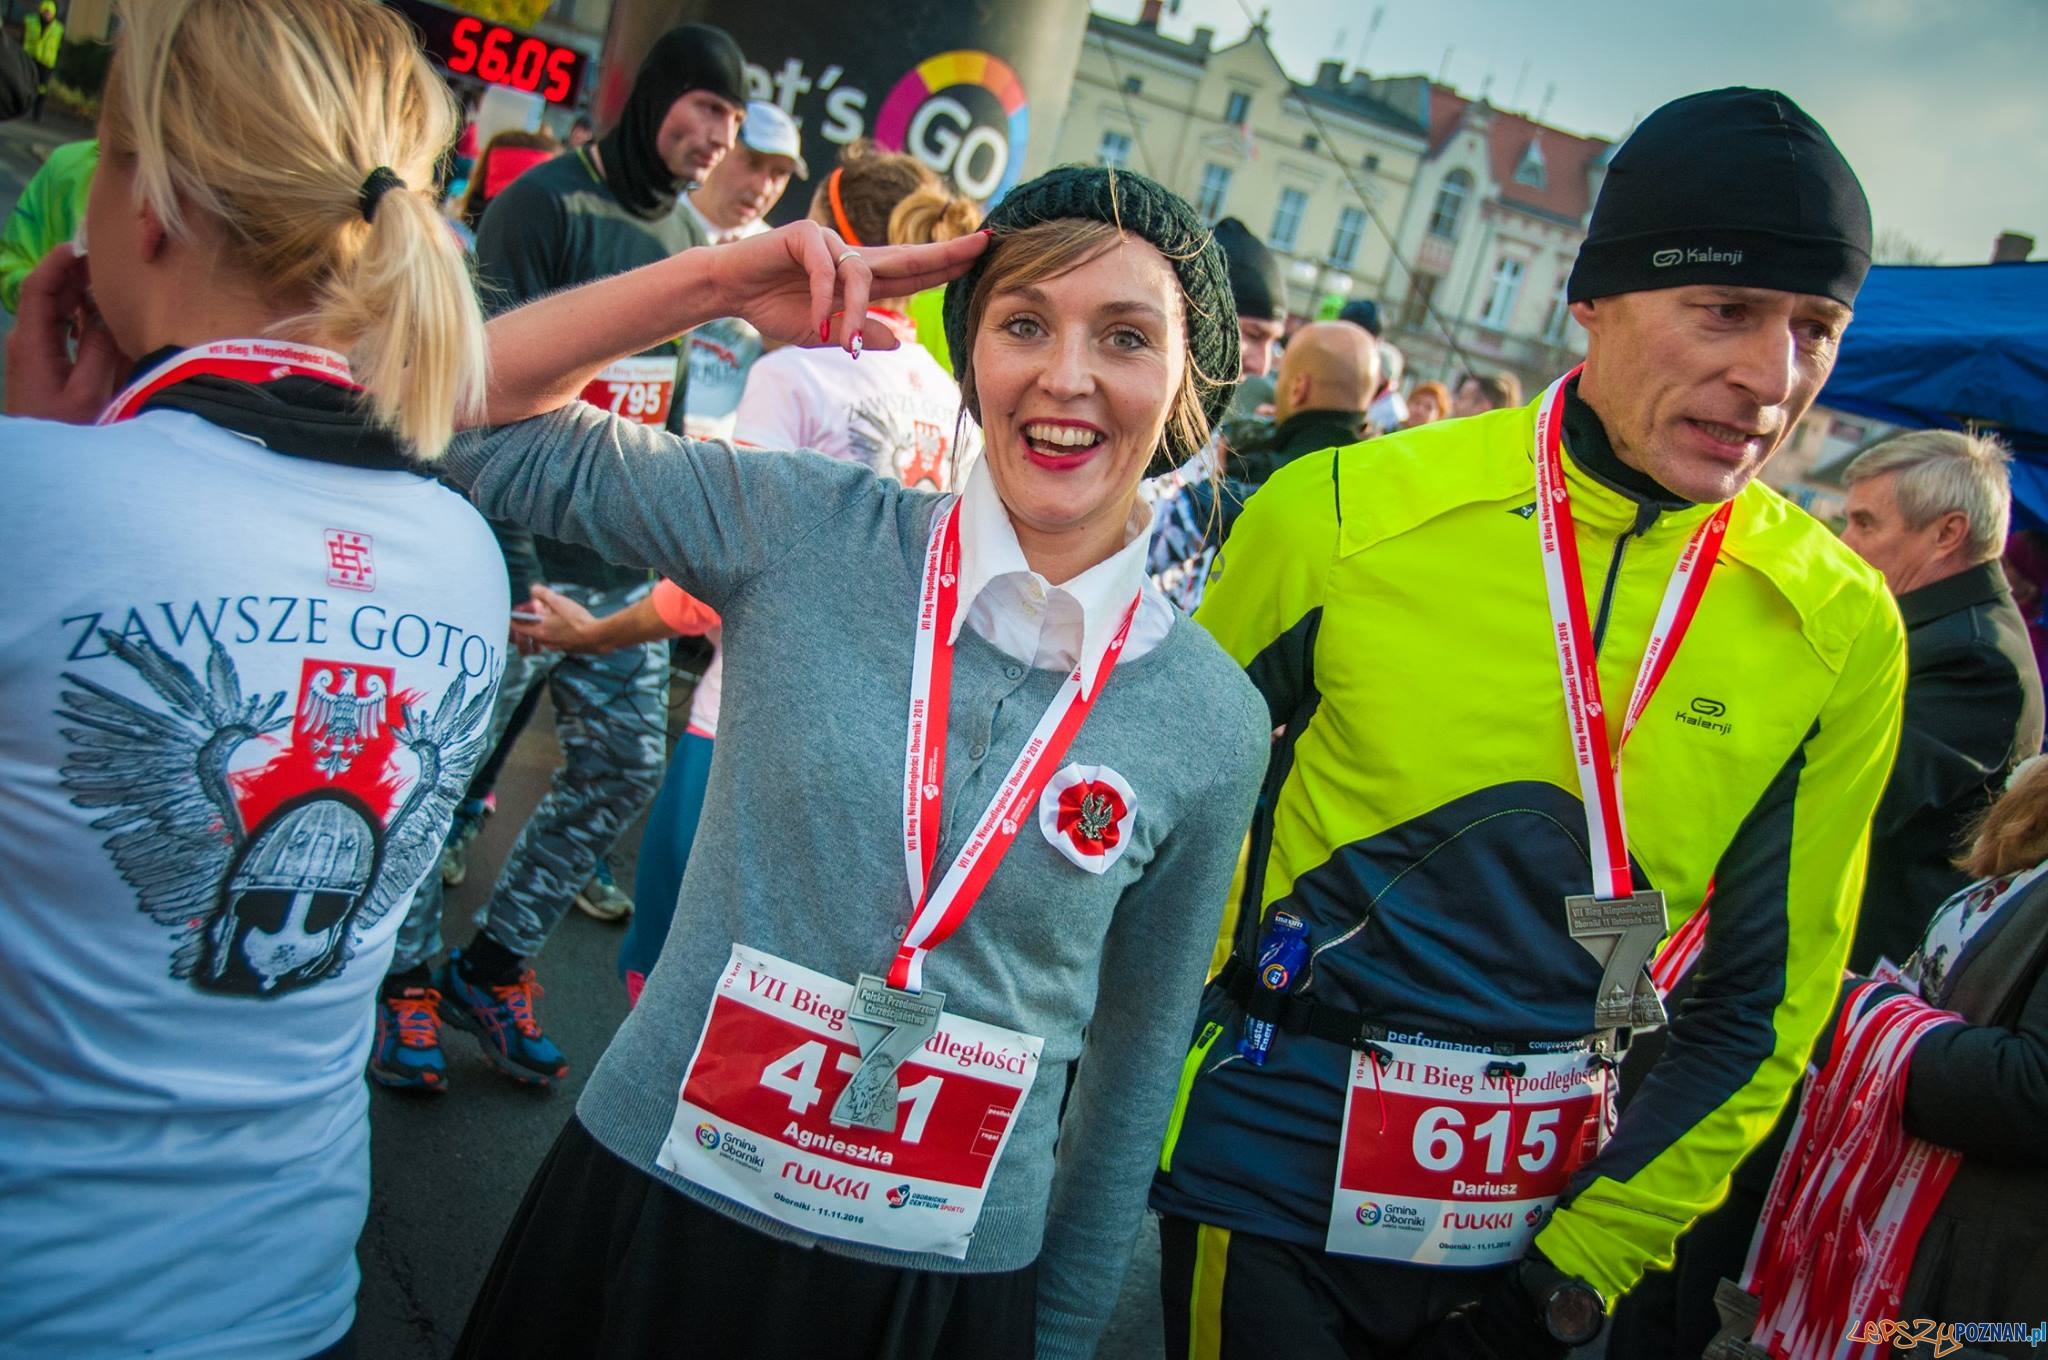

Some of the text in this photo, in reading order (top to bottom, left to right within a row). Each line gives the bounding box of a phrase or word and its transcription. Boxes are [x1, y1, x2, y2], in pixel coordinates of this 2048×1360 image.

[448, 16, 576, 102] 56.05
[907, 96, 1008, 199] GO
[1686, 246, 1743, 265] Kalenji
[607, 382, 661, 416] 795
[61, 596, 329, 662] ZAWSZE
[1558, 622, 1569, 641] 2016
[914, 698, 924, 718] 2016
[1675, 711, 1732, 736] Kalenji
[911, 721, 923, 753] Oborniki
[1577, 736, 1587, 753] Bieg
[958, 856, 969, 869] VII
[966, 838, 983, 858] Bieg
[1009, 755, 1031, 787] Oborniki
[1027, 738, 1044, 758] 2016
[907, 818, 917, 837] Bieg
[908, 838, 917, 852] VII
[724, 961, 742, 989] 10 km
[861, 989, 886, 1001] Polska
[749, 970, 1028, 1075] VII Bieg dległości
[1387, 1030, 1492, 1054] performance
[1356, 1069, 1364, 1080] 10
[1423, 1064, 1474, 1095] Bieg
[759, 1039, 945, 1144] 41
[700, 1128, 716, 1143] GO
[724, 1132, 758, 1153] Gmina
[782, 1121, 894, 1166] Agnieszka
[1412, 1106, 1561, 1173] 615
[721, 1142, 766, 1168] Oborniki
[1452, 1179, 1518, 1196] Dariusz
[773, 1192, 810, 1211] Oborniki
[818, 1207, 864, 1224] 11.11.2016
[908, 1200, 965, 1214] CENTRUM SPORTU
[911, 1193, 948, 1204] OBORNICKIE
[1360, 1208, 1377, 1220] GO
[1383, 1213, 1426, 1227] Oborniki
[1385, 1204, 1417, 1216] Gmina
[1438, 1242, 1471, 1250] Oborniki
